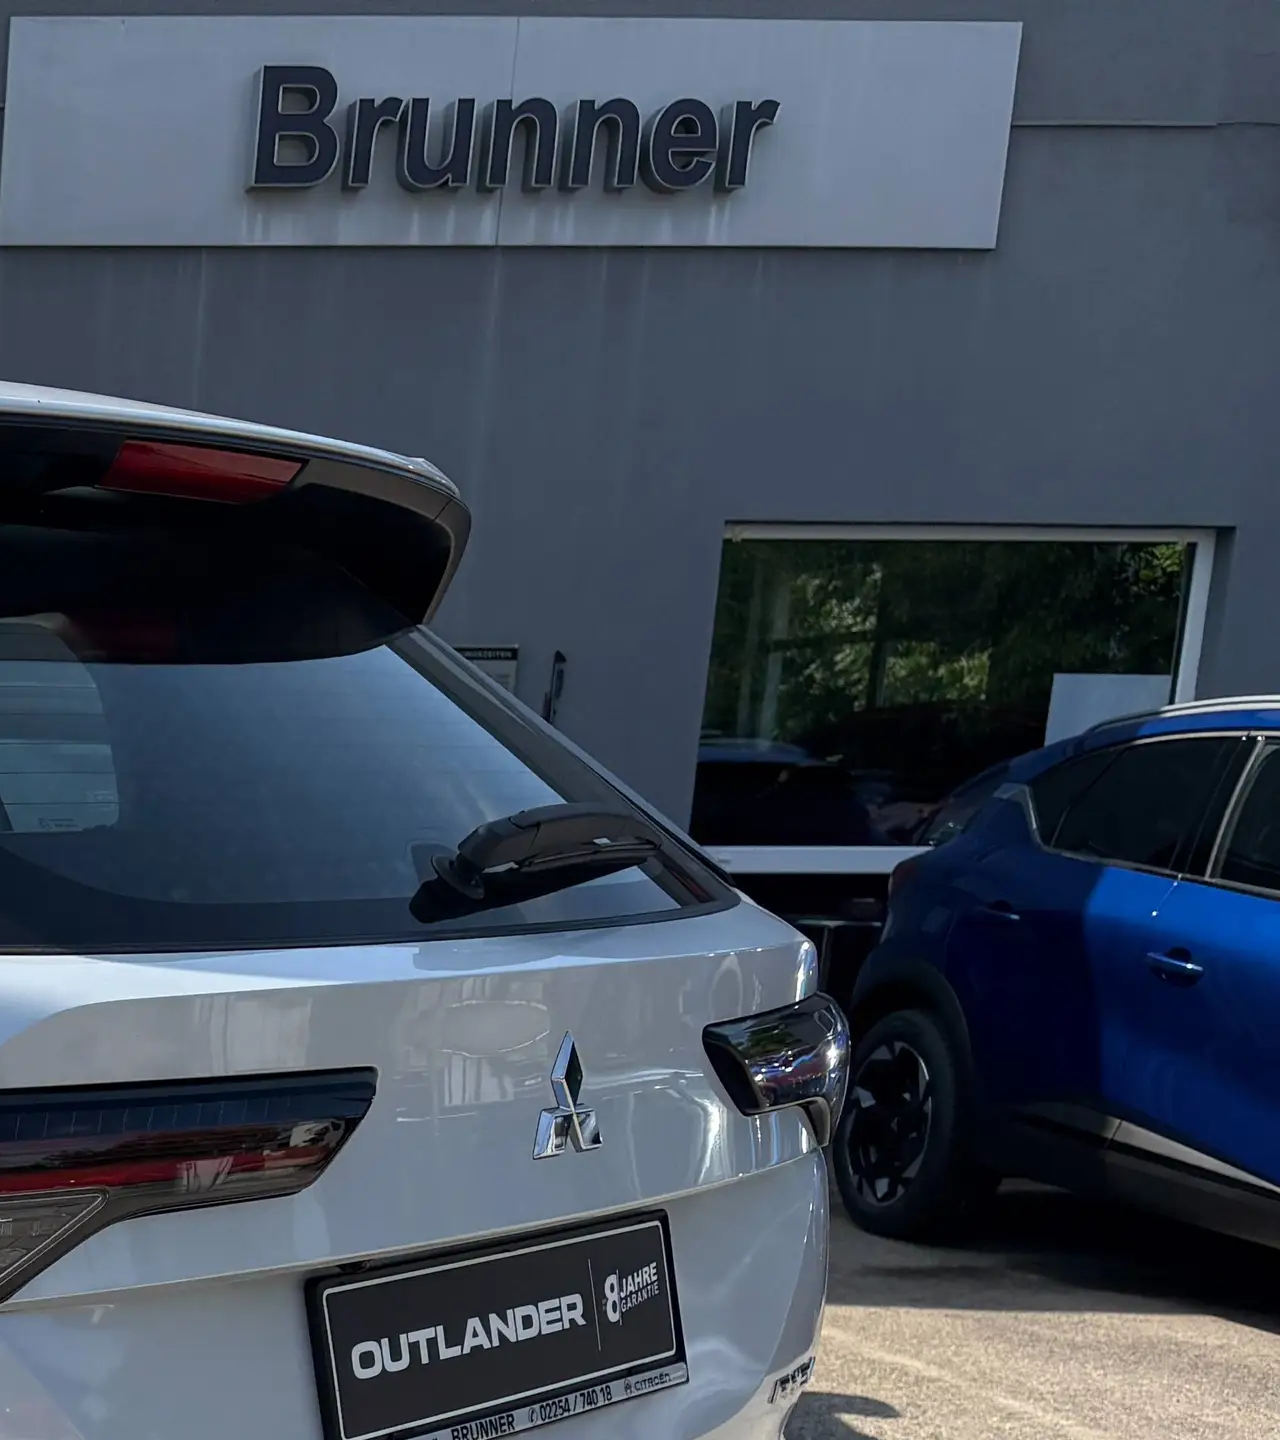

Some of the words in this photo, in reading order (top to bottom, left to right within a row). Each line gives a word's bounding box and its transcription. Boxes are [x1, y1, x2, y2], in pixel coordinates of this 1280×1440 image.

[247, 64, 781, 194] Brunner
[604, 1274, 620, 1322] 8
[620, 1262, 658, 1298] JAHRE
[621, 1281, 660, 1312] GARANTIE
[351, 1293, 587, 1380] OUTLANDER
[540, 1401, 571, 1421] 02254
[580, 1389, 598, 1409] 740
[600, 1385, 613, 1403] 18
